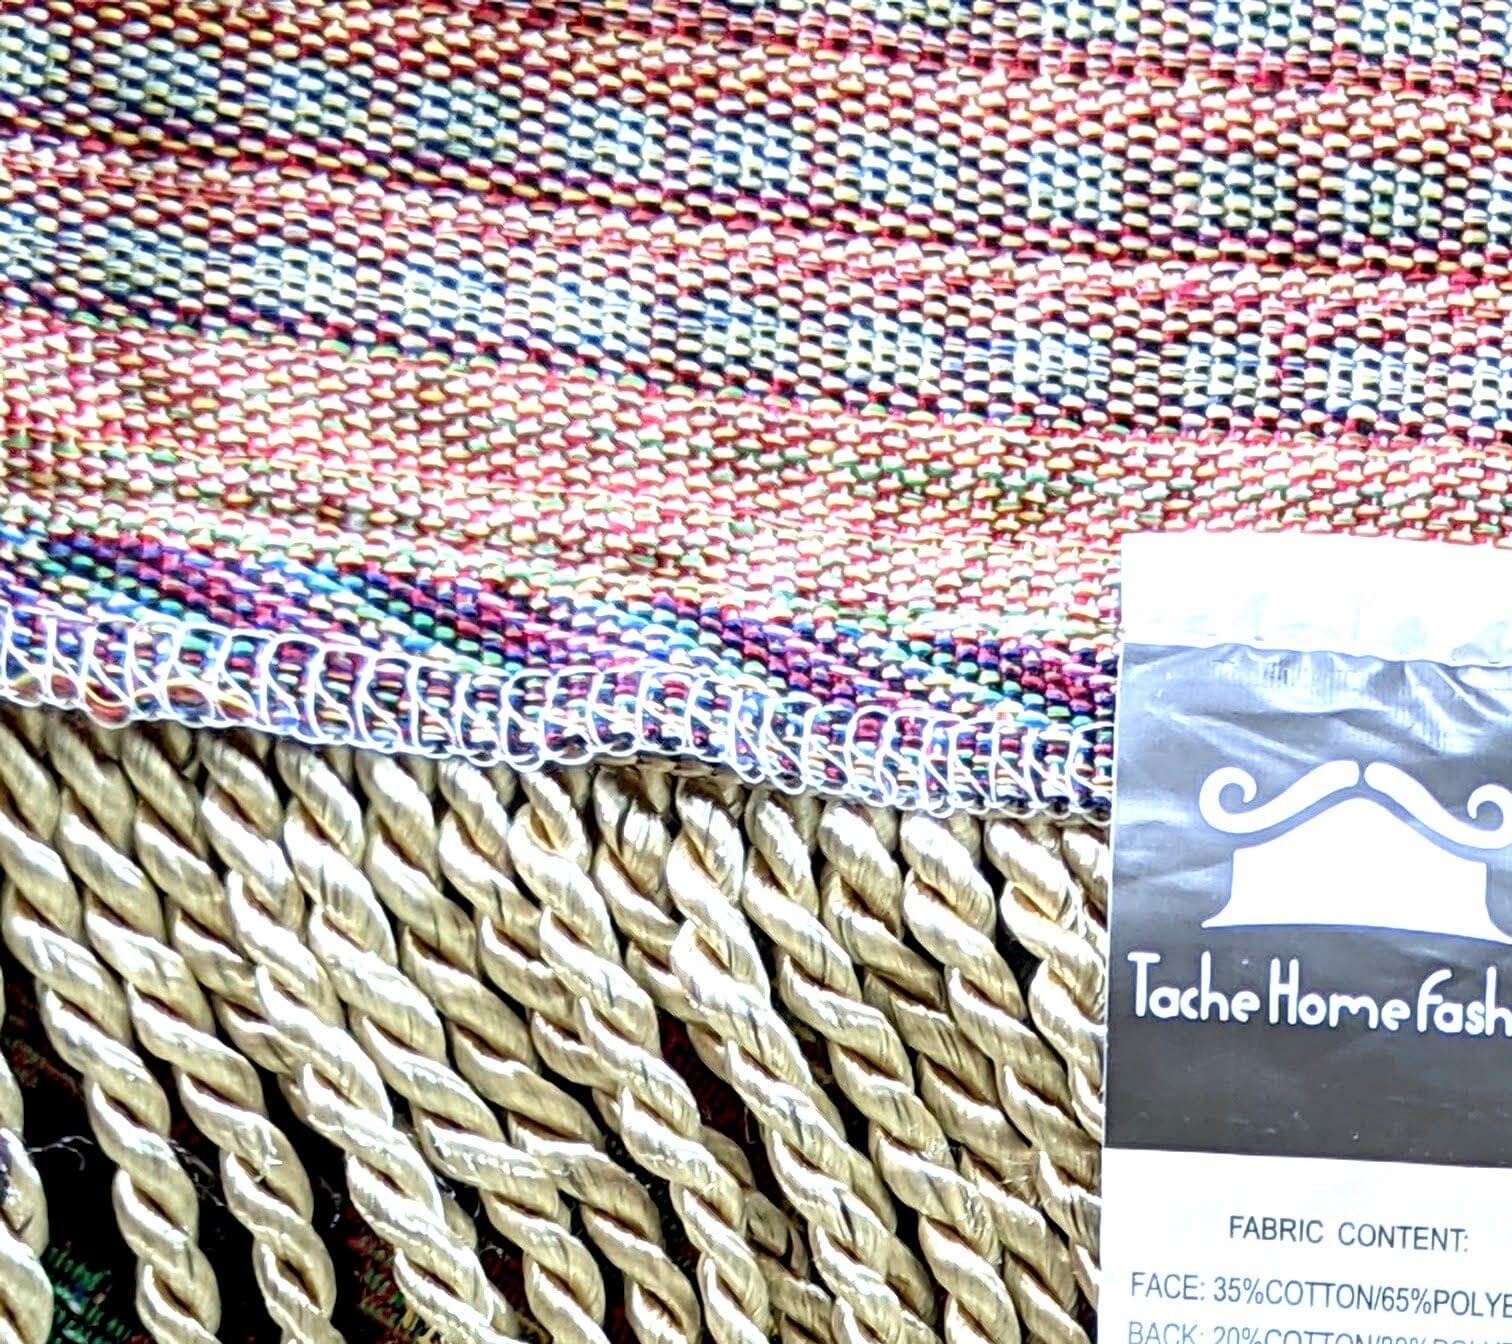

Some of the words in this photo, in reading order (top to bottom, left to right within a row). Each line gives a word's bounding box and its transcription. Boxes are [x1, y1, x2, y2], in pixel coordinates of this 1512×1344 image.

[1127, 950, 1260, 1022] Tache
[1268, 957, 1411, 1033] Home
[1229, 1215, 1324, 1244] FABRIC
[1338, 1222, 1469, 1252] CONTENT:
[1131, 1271, 1206, 1300] FACE:
